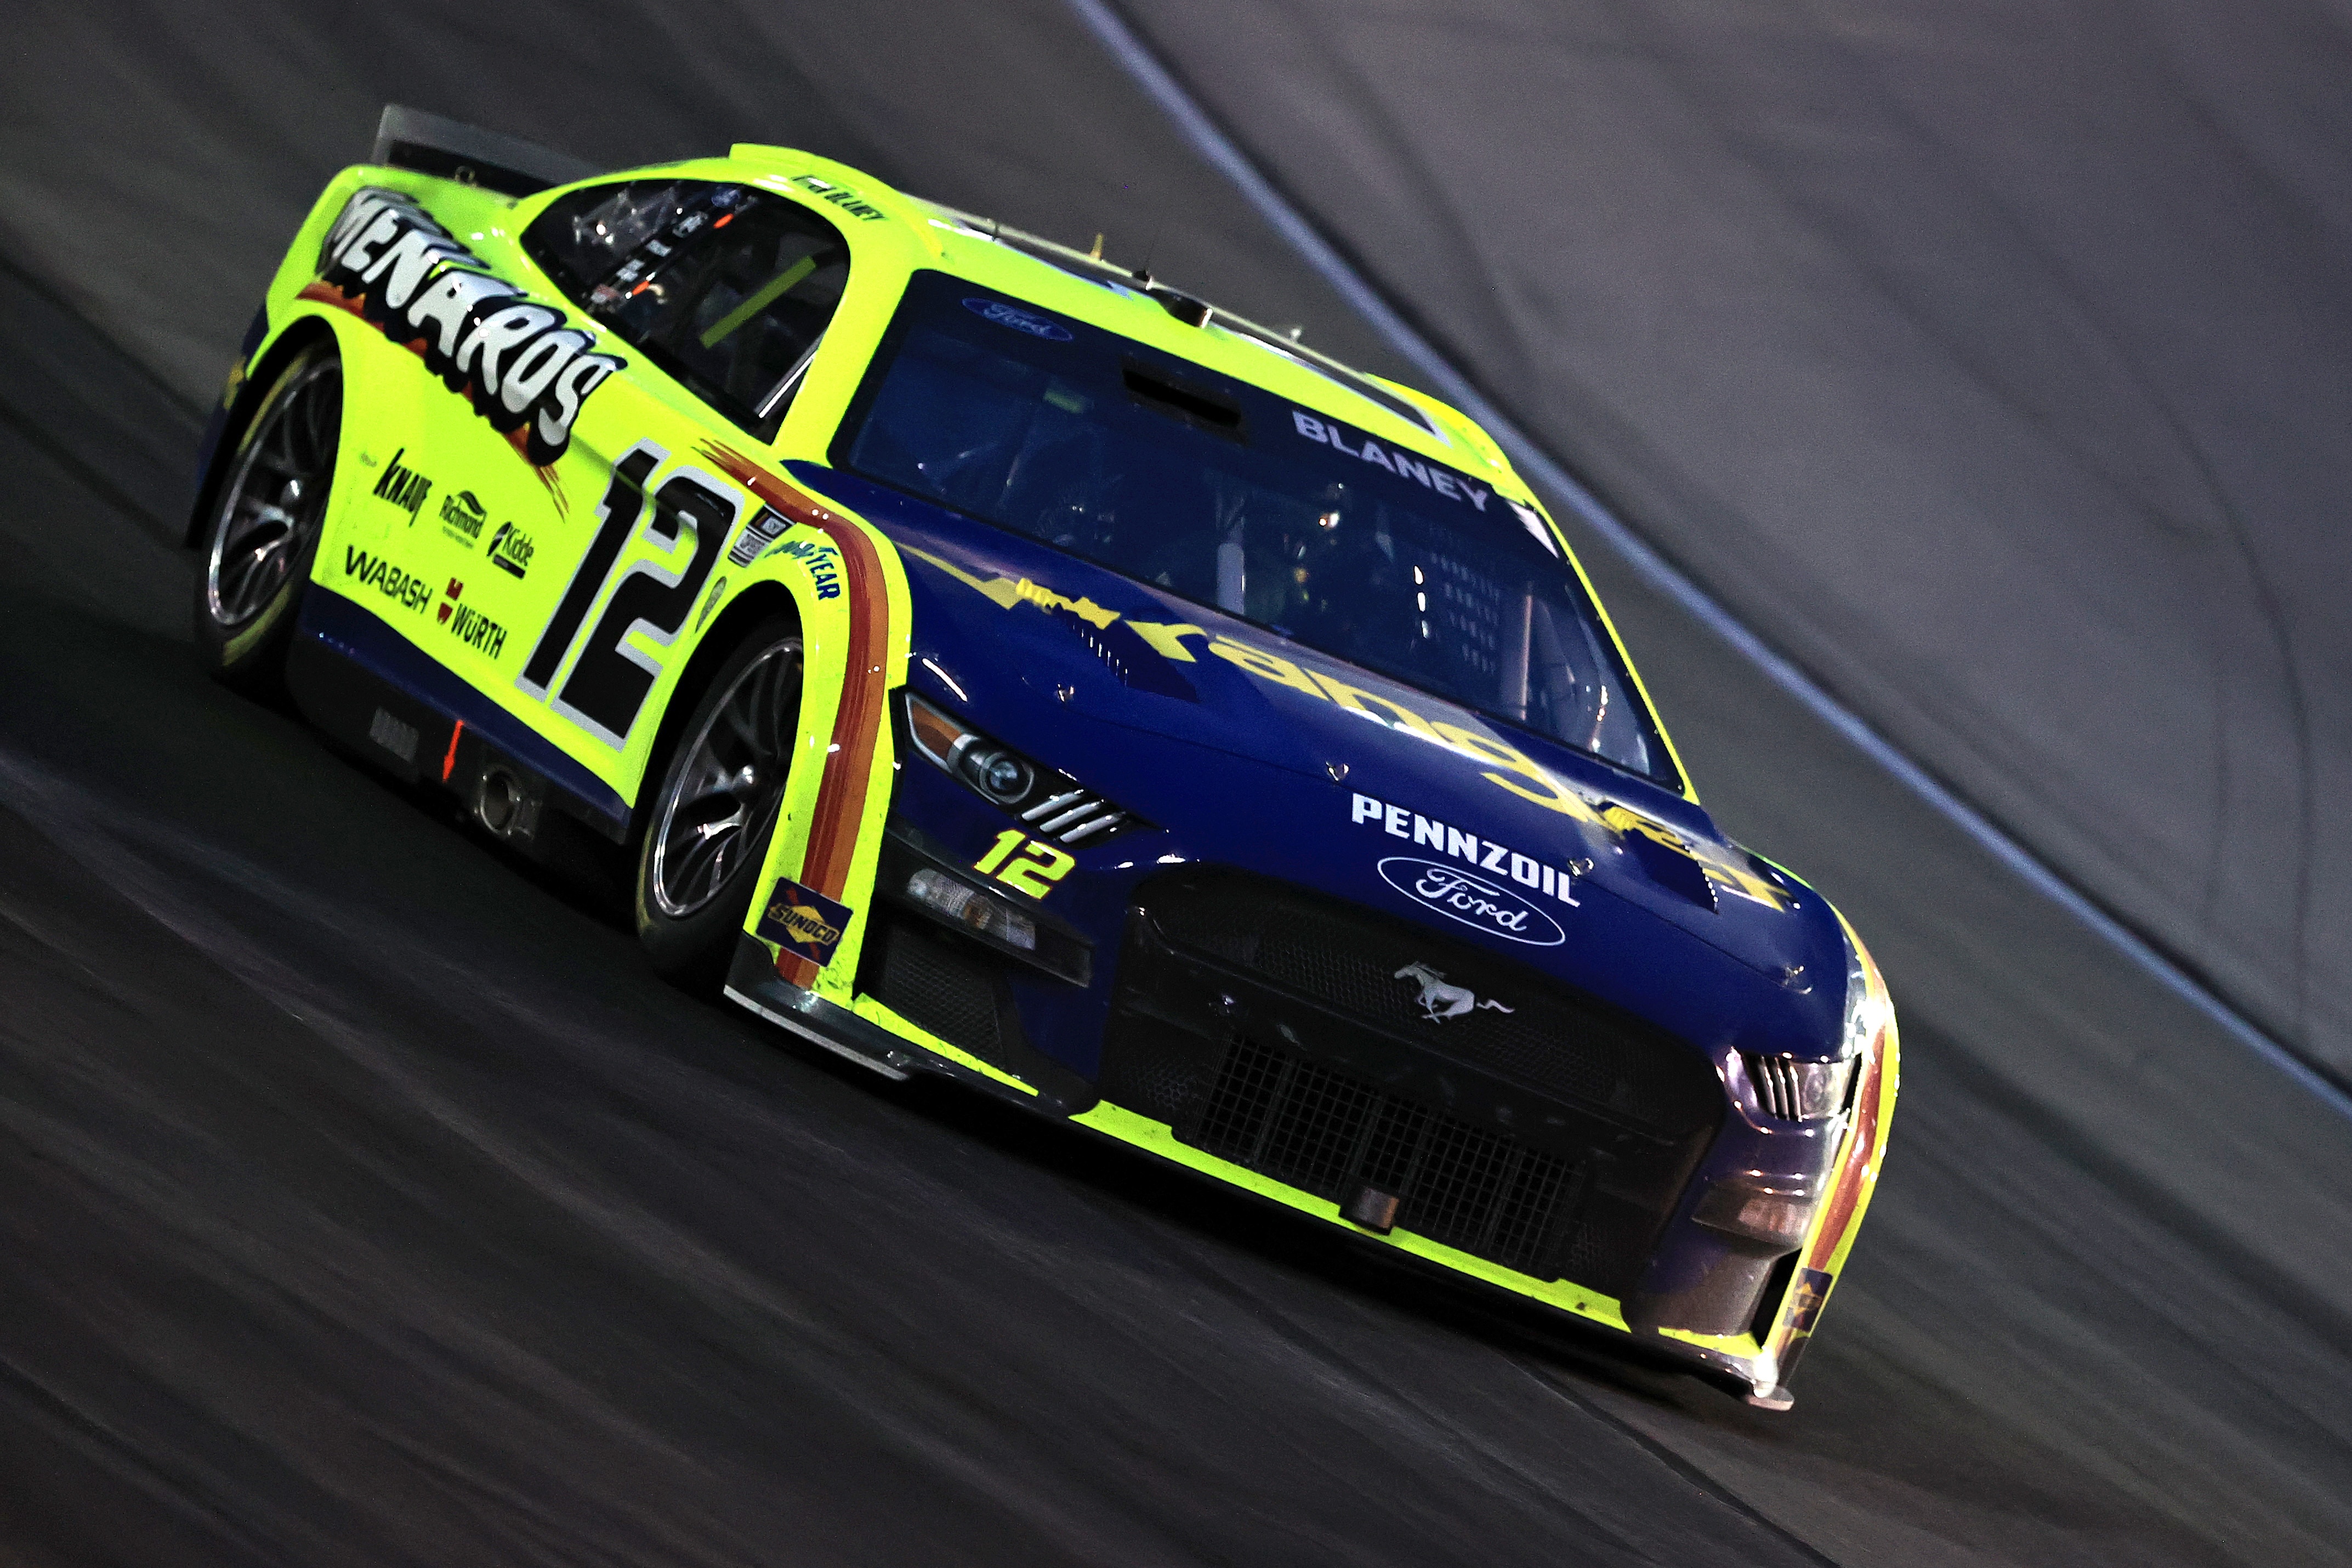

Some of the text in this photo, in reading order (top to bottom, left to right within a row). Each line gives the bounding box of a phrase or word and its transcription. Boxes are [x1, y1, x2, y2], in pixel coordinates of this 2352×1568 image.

[318, 186, 625, 450] MENARDS
[1292, 410, 1491, 513] BLANEY
[345, 545, 432, 614] WABASH
[515, 438, 744, 752] 12
[974, 829, 1075, 899] 12
[1352, 793, 1580, 907] PENNZOIL
[769, 902, 842, 947] SUNOCO
[1416, 867, 1530, 933] Ford
